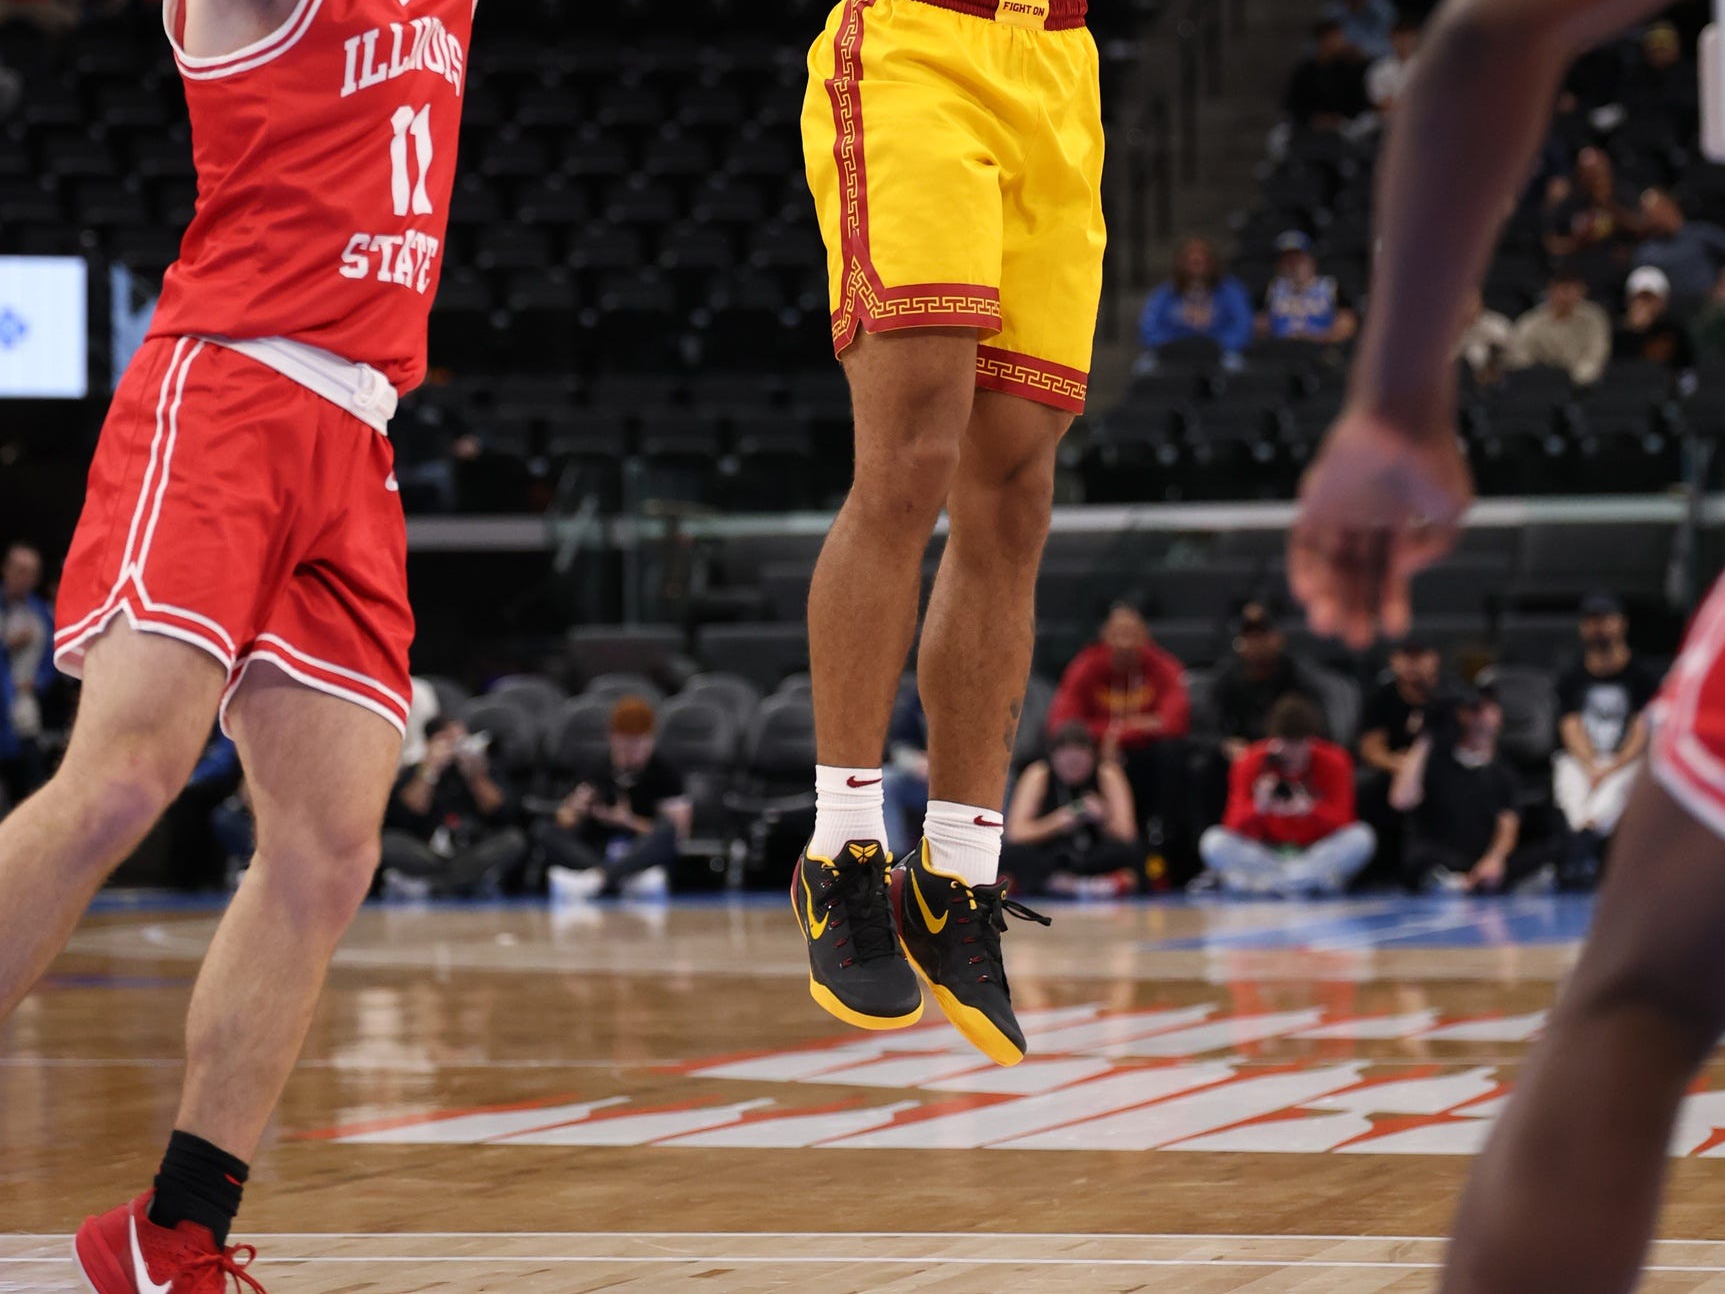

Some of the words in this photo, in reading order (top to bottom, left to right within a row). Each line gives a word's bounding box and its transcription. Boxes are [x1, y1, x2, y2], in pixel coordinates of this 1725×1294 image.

[1003, 1, 1031, 14] FIGHT
[1033, 6, 1045, 17] ON
[390, 103, 433, 217] 11
[339, 228, 439, 295] STATE
